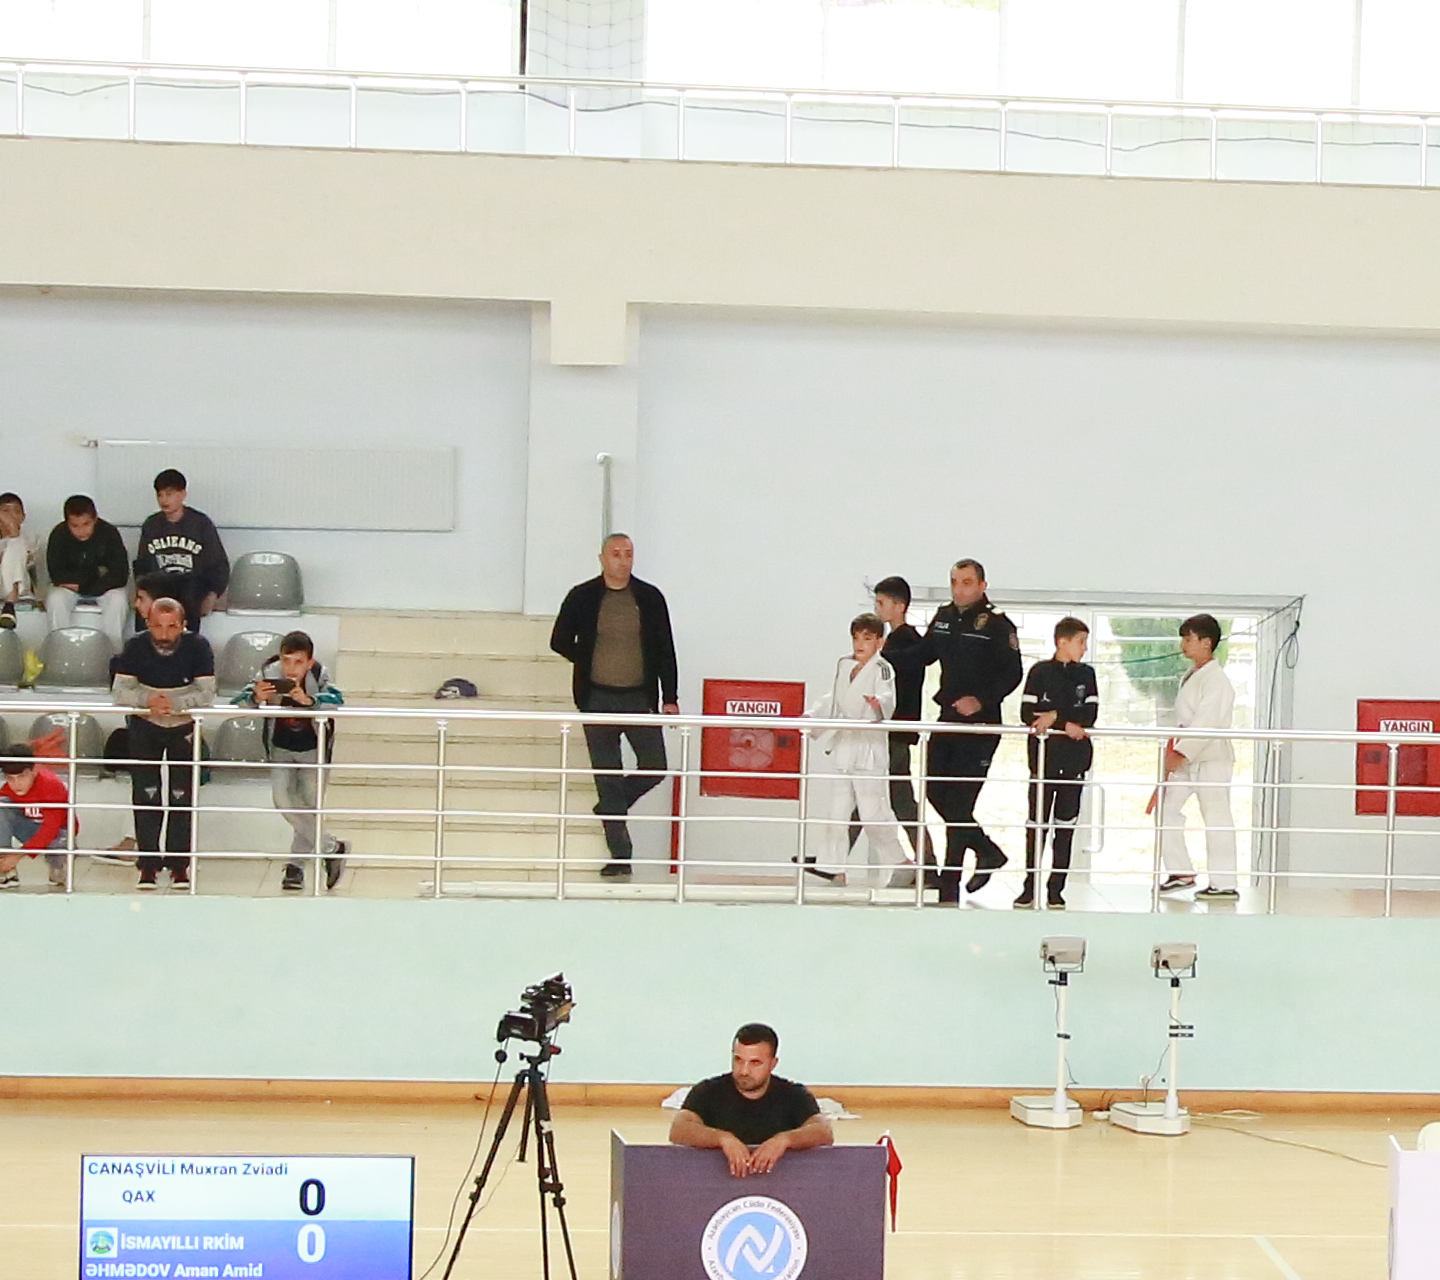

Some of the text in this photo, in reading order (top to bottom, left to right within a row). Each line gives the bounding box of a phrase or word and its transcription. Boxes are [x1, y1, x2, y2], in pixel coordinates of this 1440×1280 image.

[729, 701, 778, 714] YANGIN
[1383, 721, 1431, 732] YANGIN
[87, 1160, 288, 1178] CANAŞVİLİ Muxran Zviadi
[122, 1190, 156, 1203] QAX
[299, 1178, 326, 1216] 0
[120, 1232, 245, 1250] İSMAYILLI RKİM
[296, 1223, 326, 1263] 0
[85, 1263, 263, 1277] ƏHMƏDOV Aman Amid
